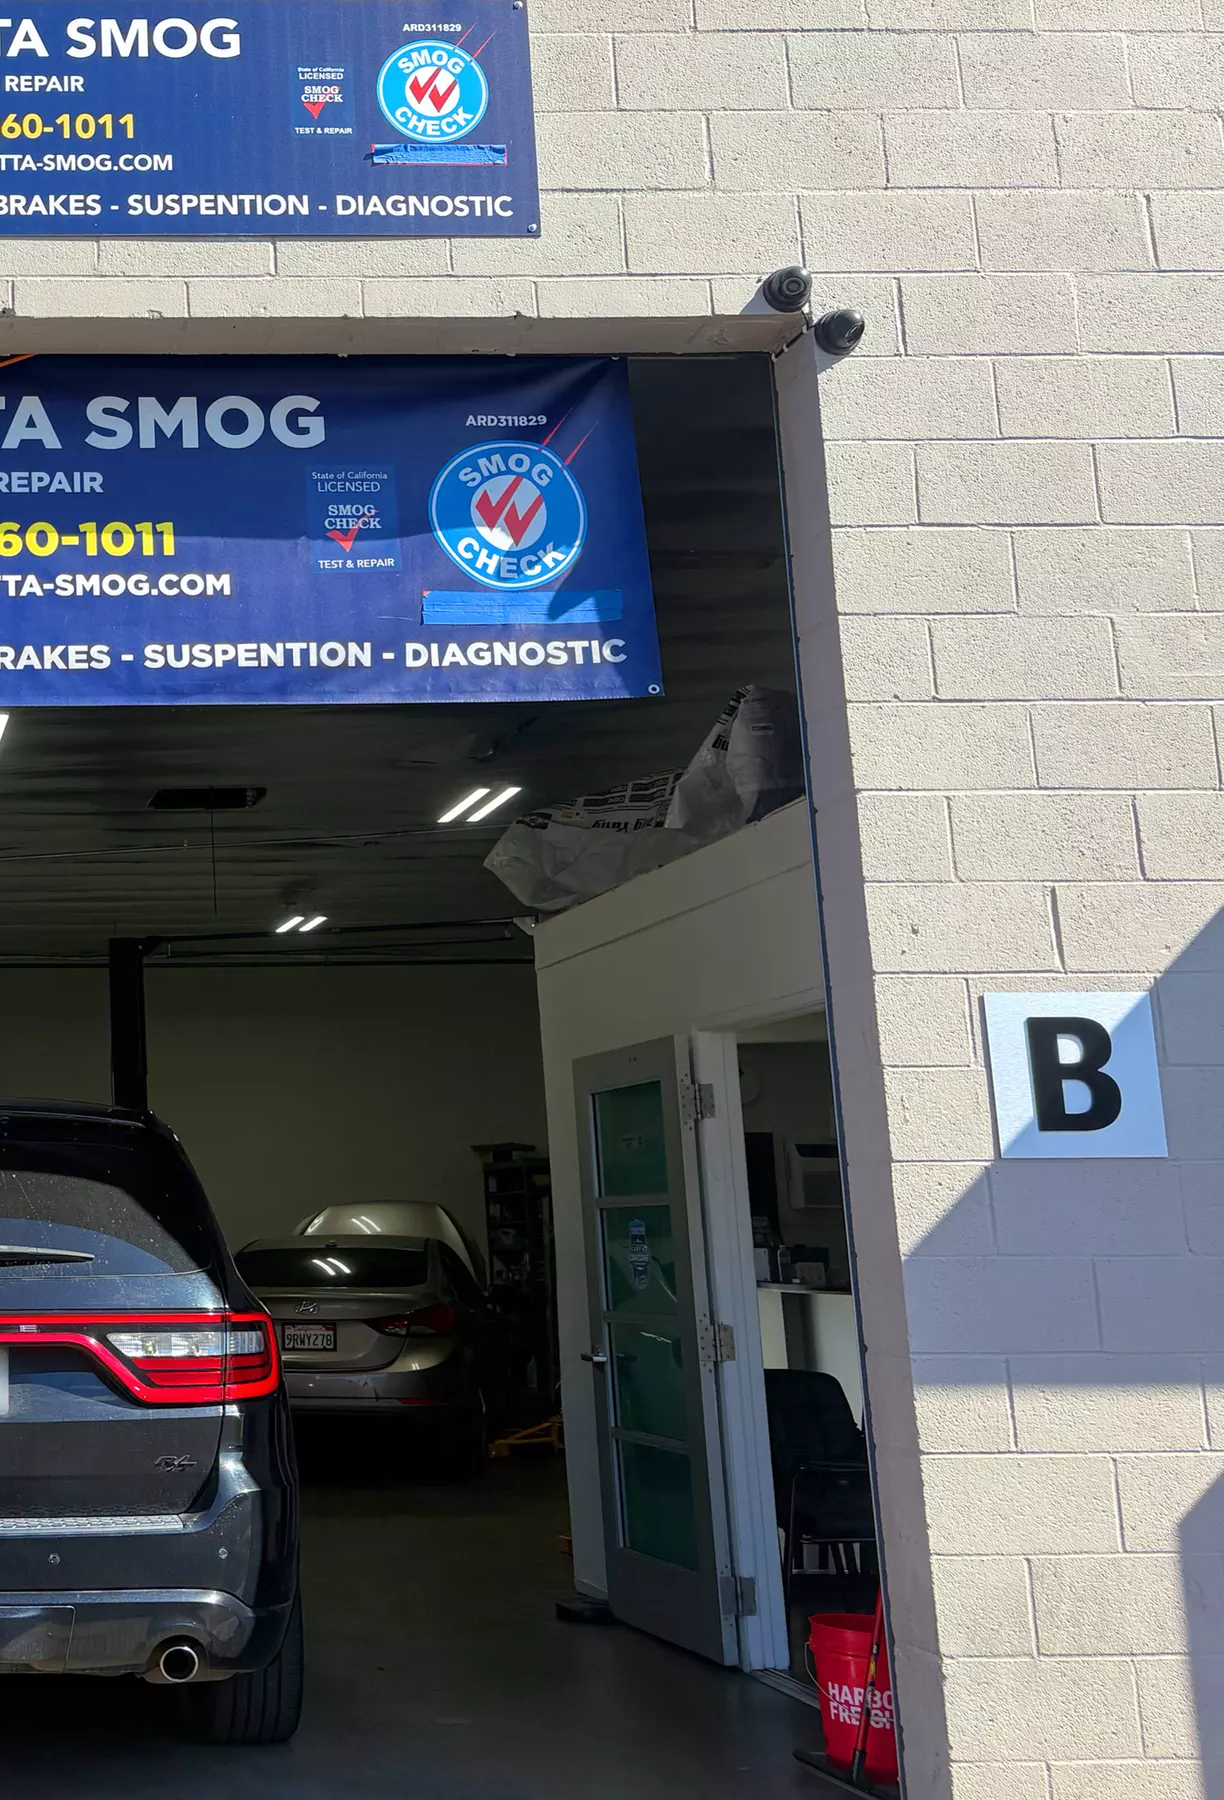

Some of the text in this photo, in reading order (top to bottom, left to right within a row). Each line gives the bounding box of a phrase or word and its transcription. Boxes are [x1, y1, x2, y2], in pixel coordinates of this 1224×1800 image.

[67, 18, 240, 58] SMOG
[397, 48, 464, 74] SMOG
[298, 72, 344, 80] LICENSED
[6, 76, 84, 91] REPAIR
[304, 86, 340, 94] SMOG
[301, 94, 343, 103] CHECK
[394, 106, 473, 136] CHECK
[128, 195, 309, 215] SUSPENTION
[337, 195, 513, 216] DIAGNOSTIC
[85, 395, 325, 449] SMOG
[466, 415, 546, 426] ARD311829
[311, 471, 388, 480] State of California
[458, 453, 553, 489] SMOG
[317, 481, 381, 492] LICENSED
[328, 504, 376, 516] SMOG
[324, 518, 382, 529] CHECK
[318, 558, 395, 568] TEST & REPAIR
[457, 536, 566, 580] CHECK
[143, 641, 372, 669] SUSPENTION
[405, 638, 627, 667] DIAGNOSTIC
[1025, 1017, 1122, 1131] B
[286, 1333, 333, 1346] 9RWY278
